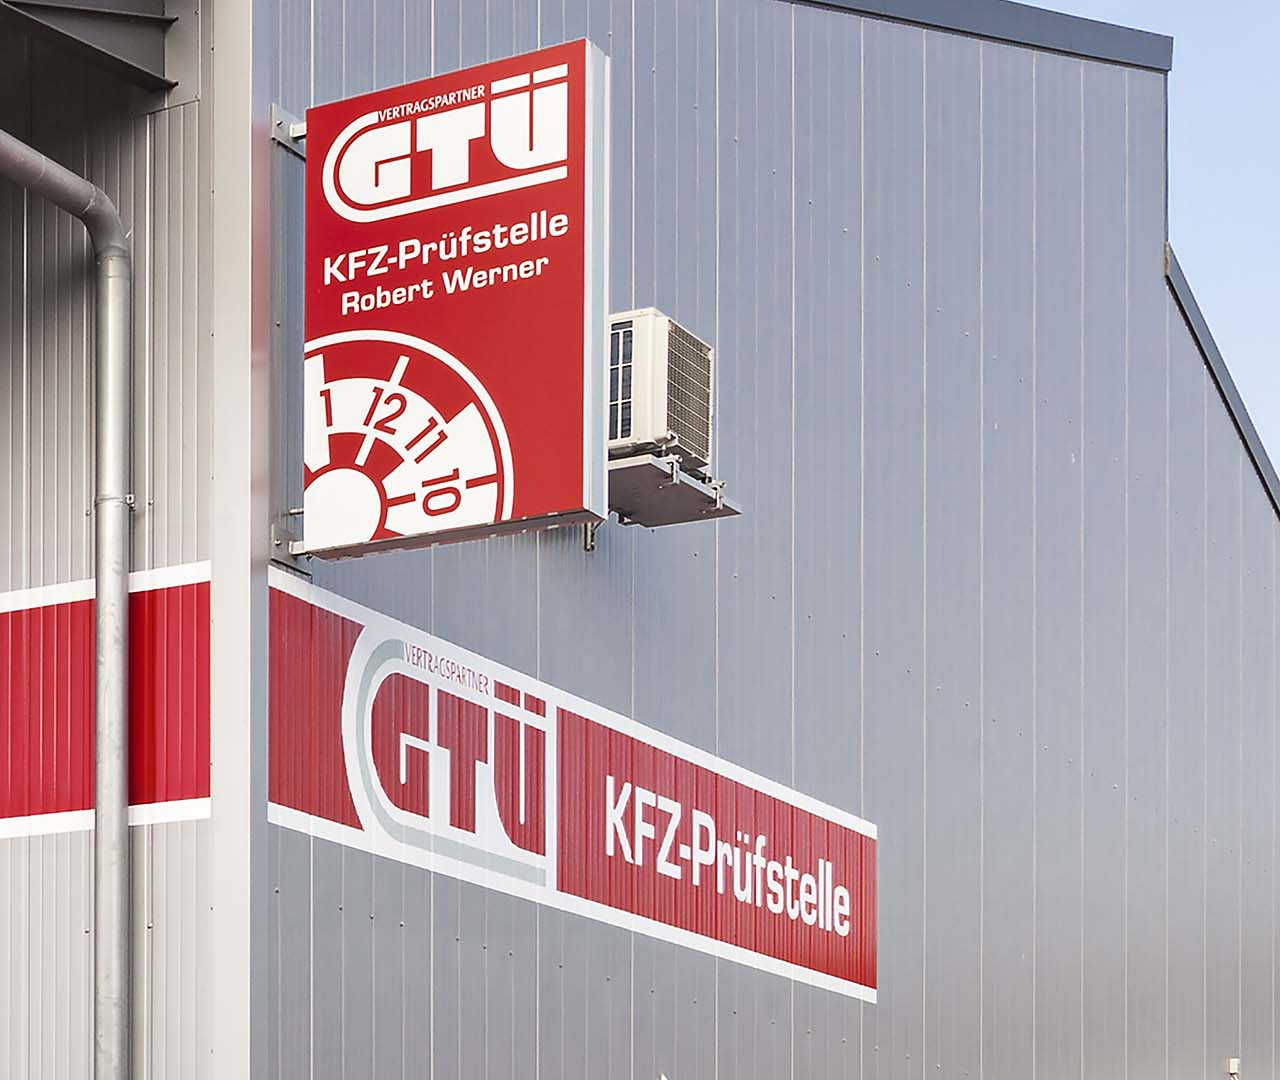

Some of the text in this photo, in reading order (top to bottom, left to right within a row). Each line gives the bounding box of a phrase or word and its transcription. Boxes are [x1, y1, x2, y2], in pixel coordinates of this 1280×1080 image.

[378, 85, 485, 122] VERTRAGSPARTNER
[339, 63, 569, 206] GTÜ
[324, 210, 569, 285] KFZ-Prüfstelle
[341, 256, 549, 316] Robert Werner
[362, 386, 407, 435] 12
[404, 416, 448, 464] 11
[421, 468, 462, 516] 10
[404, 642, 489, 695] VERTRAGSPARTNER
[371, 679, 547, 858] GTÜ
[605, 775, 850, 937] KFZ-Prüfstelle
